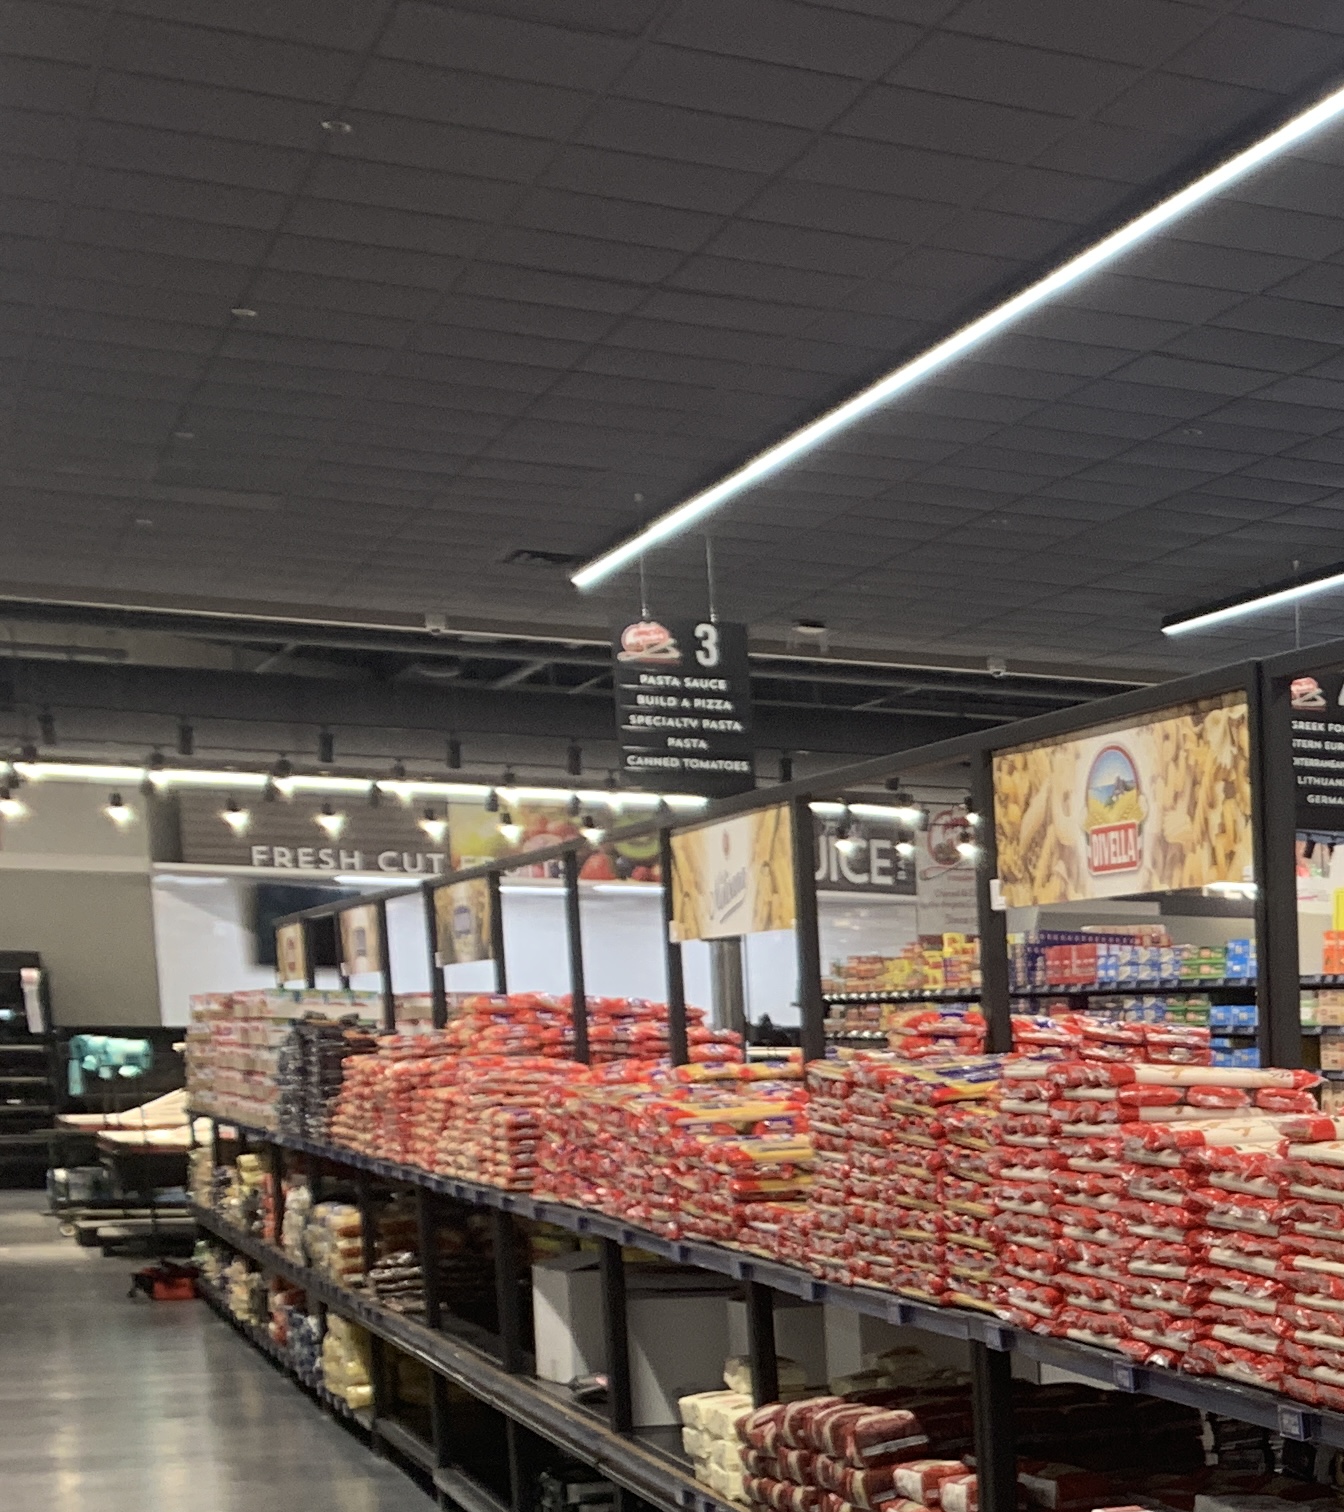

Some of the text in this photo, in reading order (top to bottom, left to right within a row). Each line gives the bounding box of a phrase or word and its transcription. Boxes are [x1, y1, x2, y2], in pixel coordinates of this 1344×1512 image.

[694, 623, 719, 667] 3
[640, 675, 727, 690] PASTA SAUCE
[637, 694, 732, 710] BUILD A PIZZA
[629, 715, 743, 731] SPECIALTY PASTA
[667, 737, 709, 750] PASTA
[1292, 739, 1323, 749] TERN
[627, 755, 749, 771] CANNED TOMATOES
[1092, 829, 1137, 864] DIVELLA
[251, 845, 364, 871] FRESH
[378, 851, 445, 874] CUT
